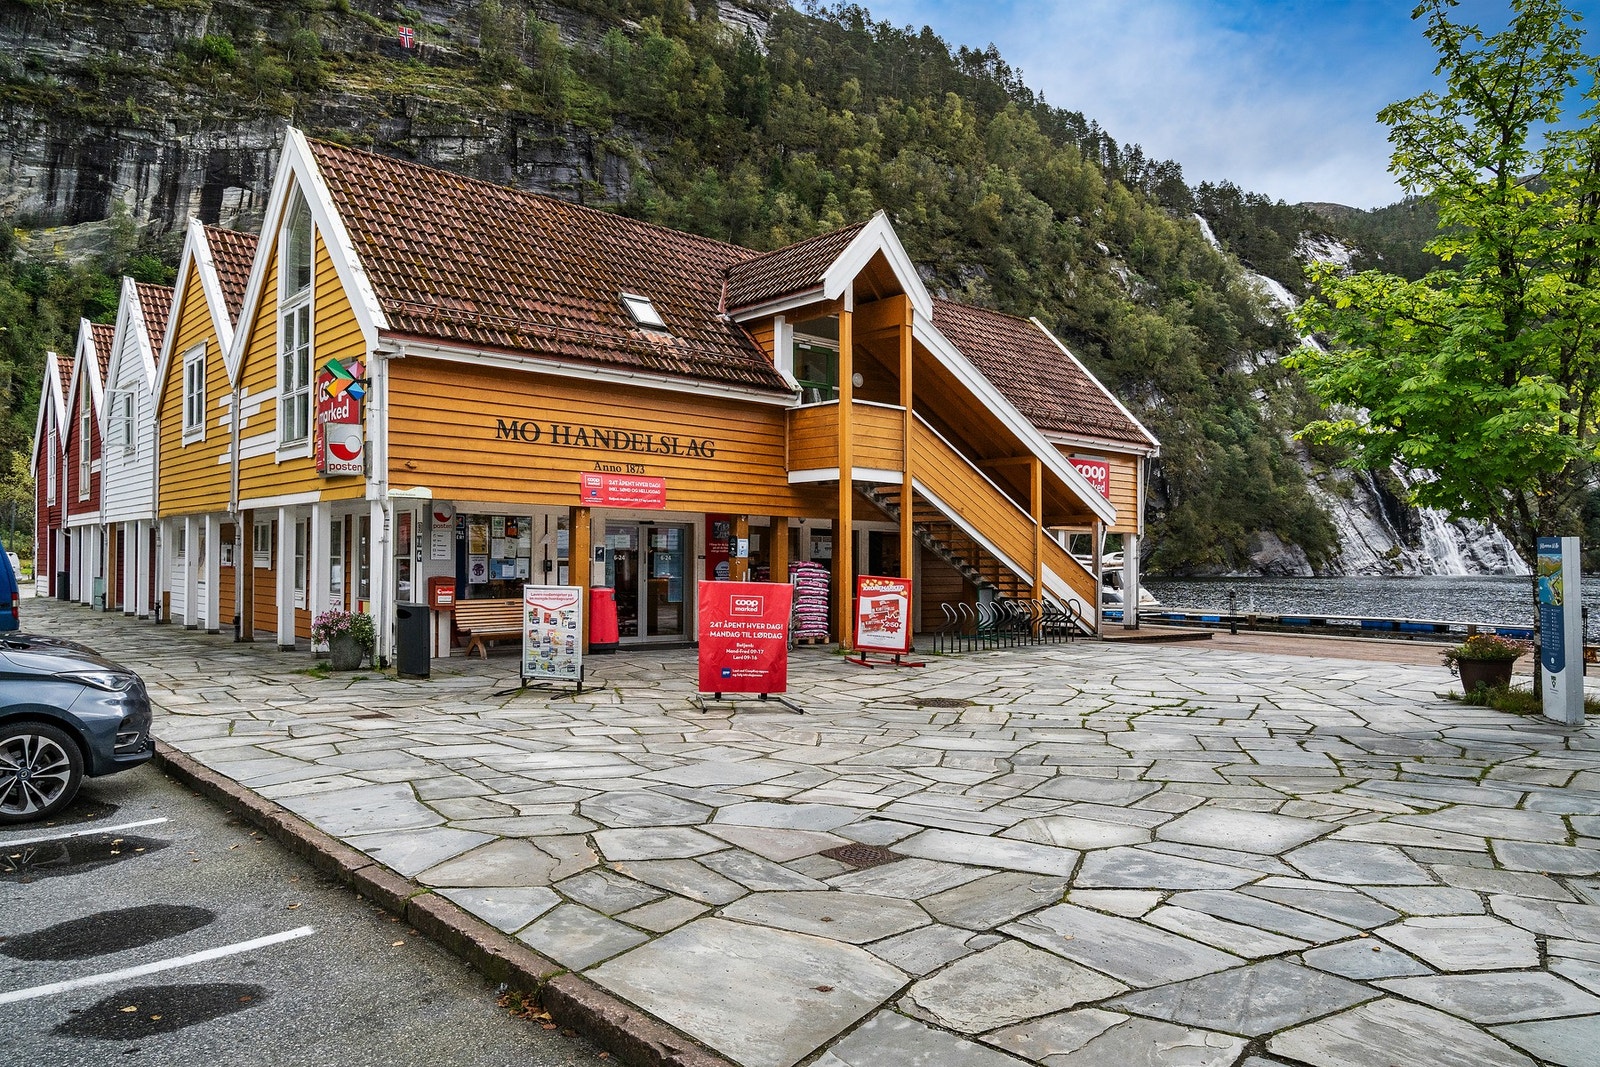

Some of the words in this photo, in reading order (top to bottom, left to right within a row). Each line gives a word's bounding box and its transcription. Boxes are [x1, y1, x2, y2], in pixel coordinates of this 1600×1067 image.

[319, 399, 350, 422] marked
[495, 418, 541, 442] MO
[550, 424, 717, 458] HANDELSLAG
[328, 463, 363, 472] posten
[593, 461, 622, 473] Anno
[625, 464, 645, 474] 1873
[723, 620, 746, 629] ÅPENT
